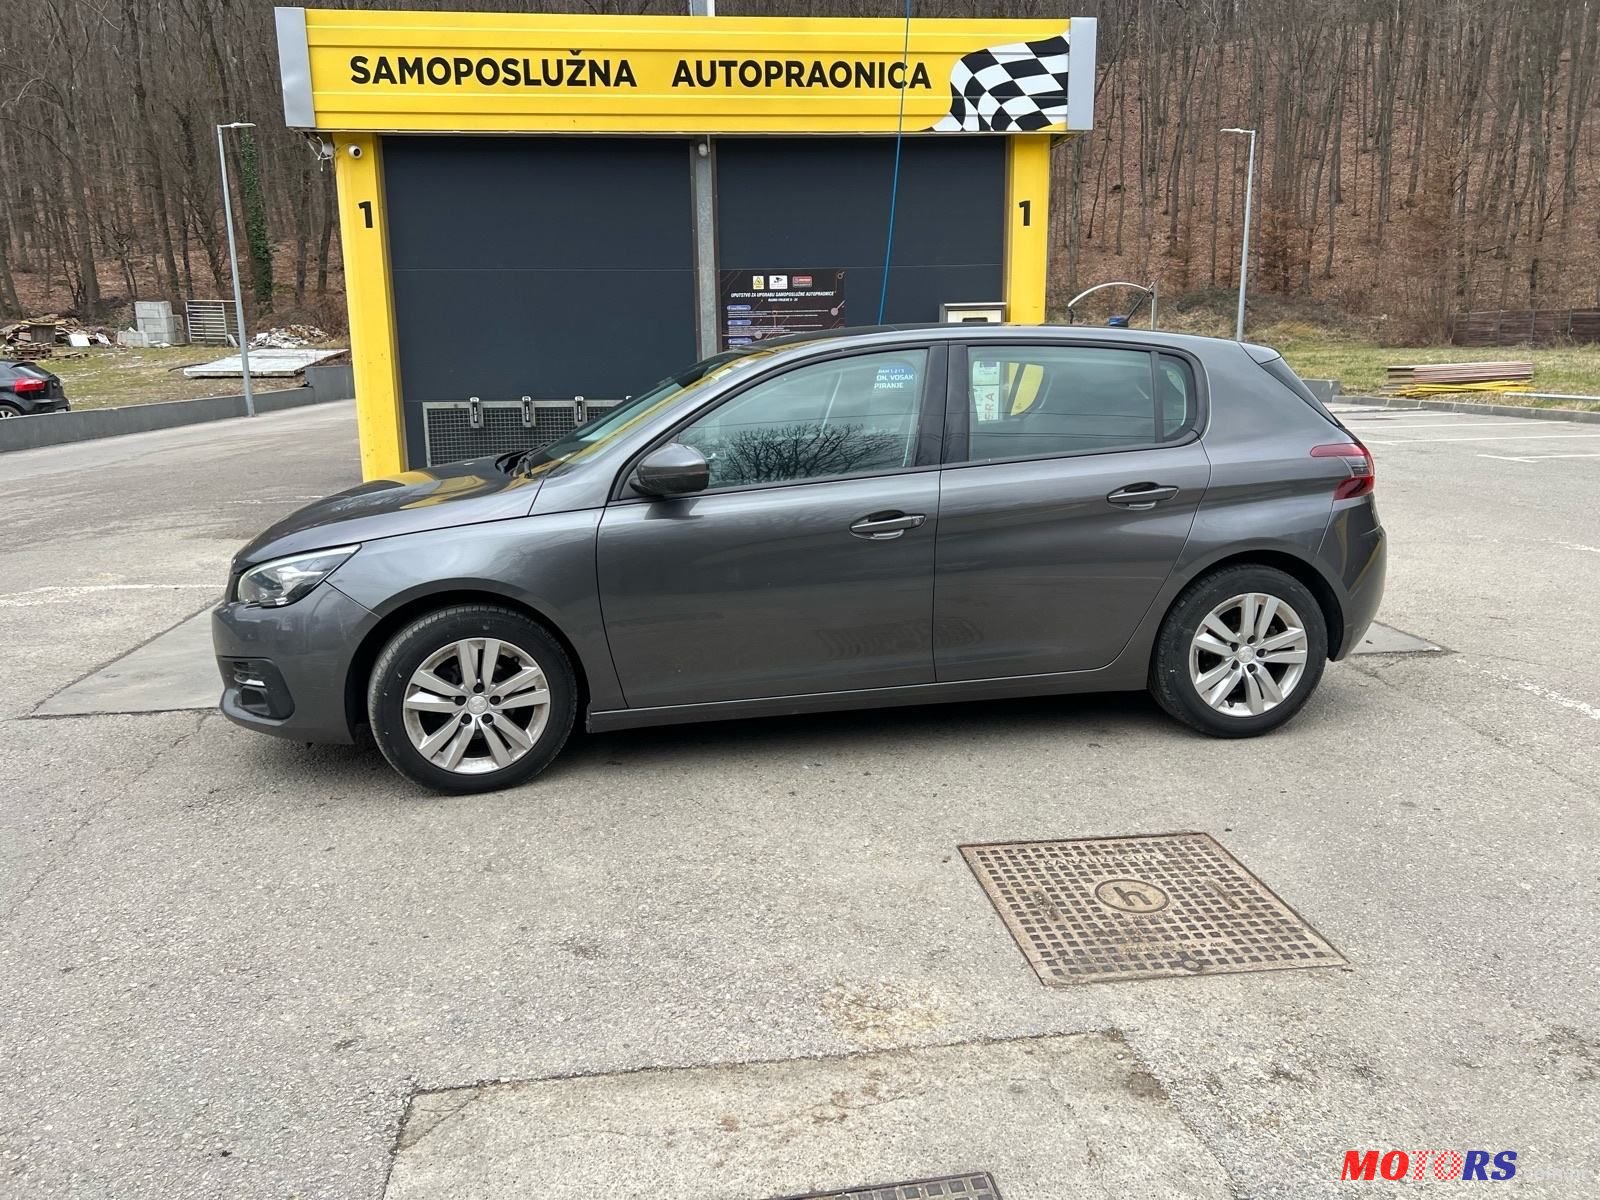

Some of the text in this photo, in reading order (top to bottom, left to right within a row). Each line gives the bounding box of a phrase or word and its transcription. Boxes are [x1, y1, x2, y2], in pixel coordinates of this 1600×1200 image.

[350, 50, 932, 89] SAMOPOSLUŽNA AUTOPRAONICA
[358, 201, 373, 228] 1
[1019, 200, 1030, 226] 1
[1043, 855, 1159, 866] KANALIZACIJA
